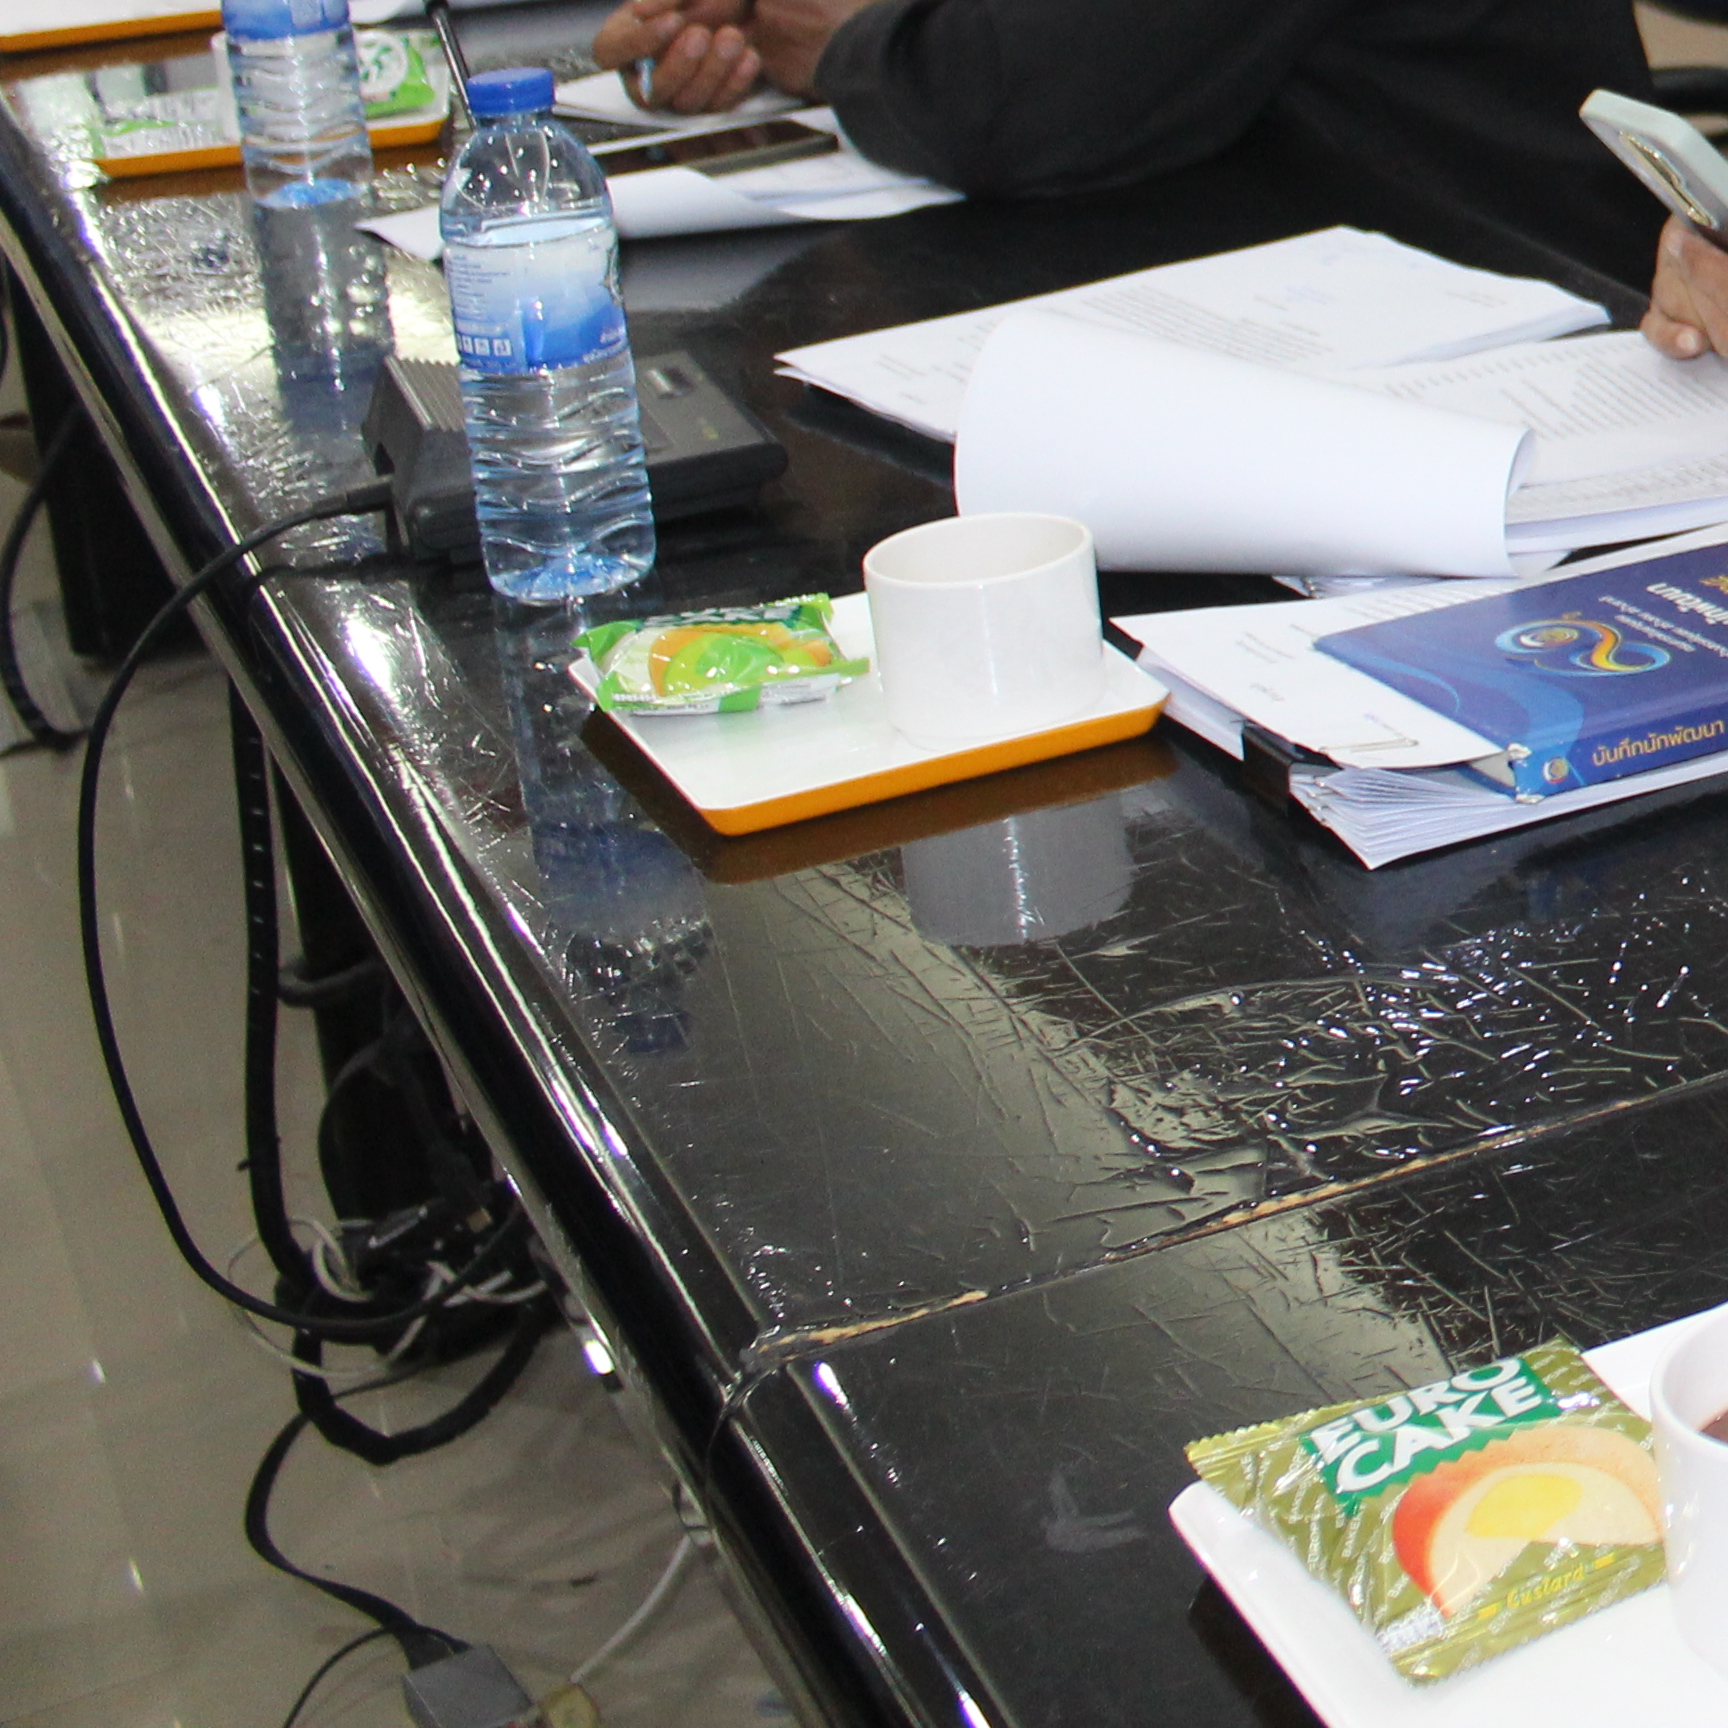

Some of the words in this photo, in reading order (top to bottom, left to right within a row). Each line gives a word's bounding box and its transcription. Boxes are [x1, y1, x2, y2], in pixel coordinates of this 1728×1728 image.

[1592, 718, 1725, 767] บันทึกนักพัฒนา
[1309, 1358, 1522, 1467] EURO
[1335, 1375, 1544, 1494] CAKE
[1506, 1561, 1585, 1609] Custard
